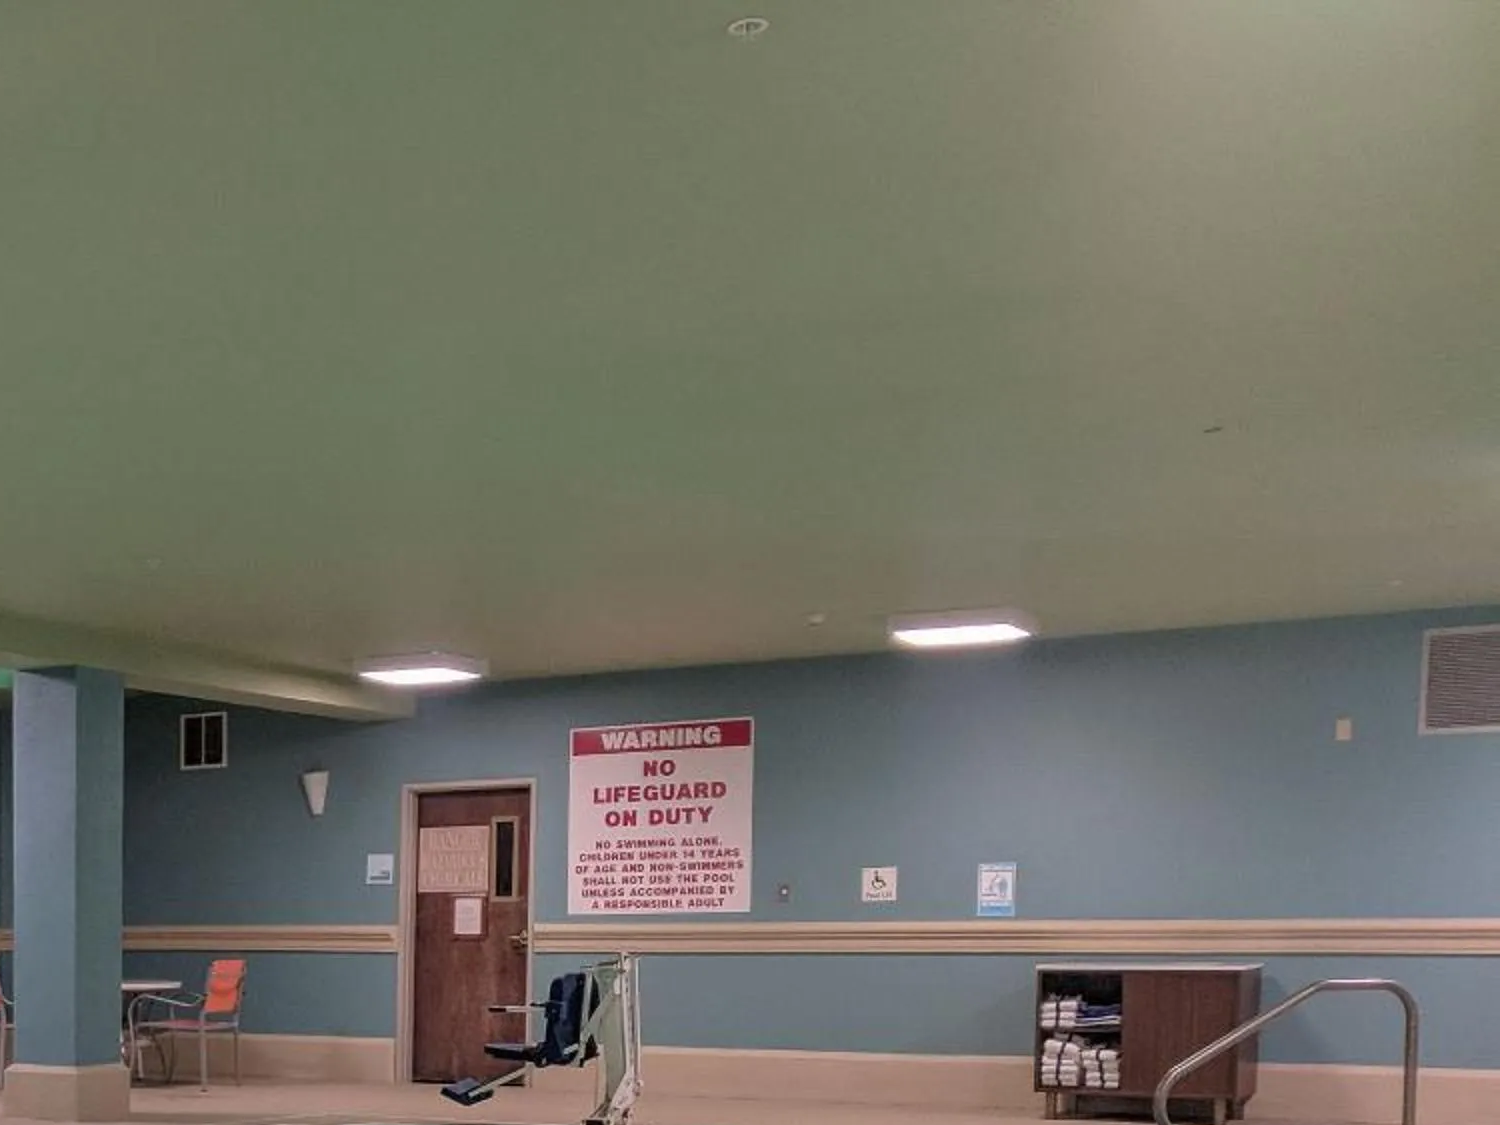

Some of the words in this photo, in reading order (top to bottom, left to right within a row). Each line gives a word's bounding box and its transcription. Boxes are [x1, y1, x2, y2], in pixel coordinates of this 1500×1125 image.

[601, 726, 722, 750] WARNING
[643, 760, 676, 777] NO
[593, 782, 727, 804] LIFEGUARD
[605, 810, 637, 827] ON
[649, 806, 713, 825] DUTY
[595, 841, 611, 849] NO
[616, 838, 676, 848] SWIMMING
[579, 851, 634, 862] CHILDREN
[639, 851, 677, 860] UNDER
[683, 850, 695, 858] 14
[701, 848, 740, 858] YEARS
[575, 865, 588, 874] OF
[593, 864, 617, 873] AGE
[622, 863, 645, 873] AND
[649, 860, 743, 872] NON-SWIMMERS
[583, 876, 616, 886] SHALL
[622, 875, 644, 884] NOT
[649, 874, 671, 884] USE
[677, 874, 698, 883] THE
[703, 873, 735, 882] POOL
[582, 887, 625, 897] UNLESS
[629, 885, 714, 896] ACCOMPANIED
[719, 886, 735, 894] BY
[591, 900, 599, 909] A
[603, 899, 682, 909] RESPONSIBLE
[688, 897, 724, 907] ADULT
